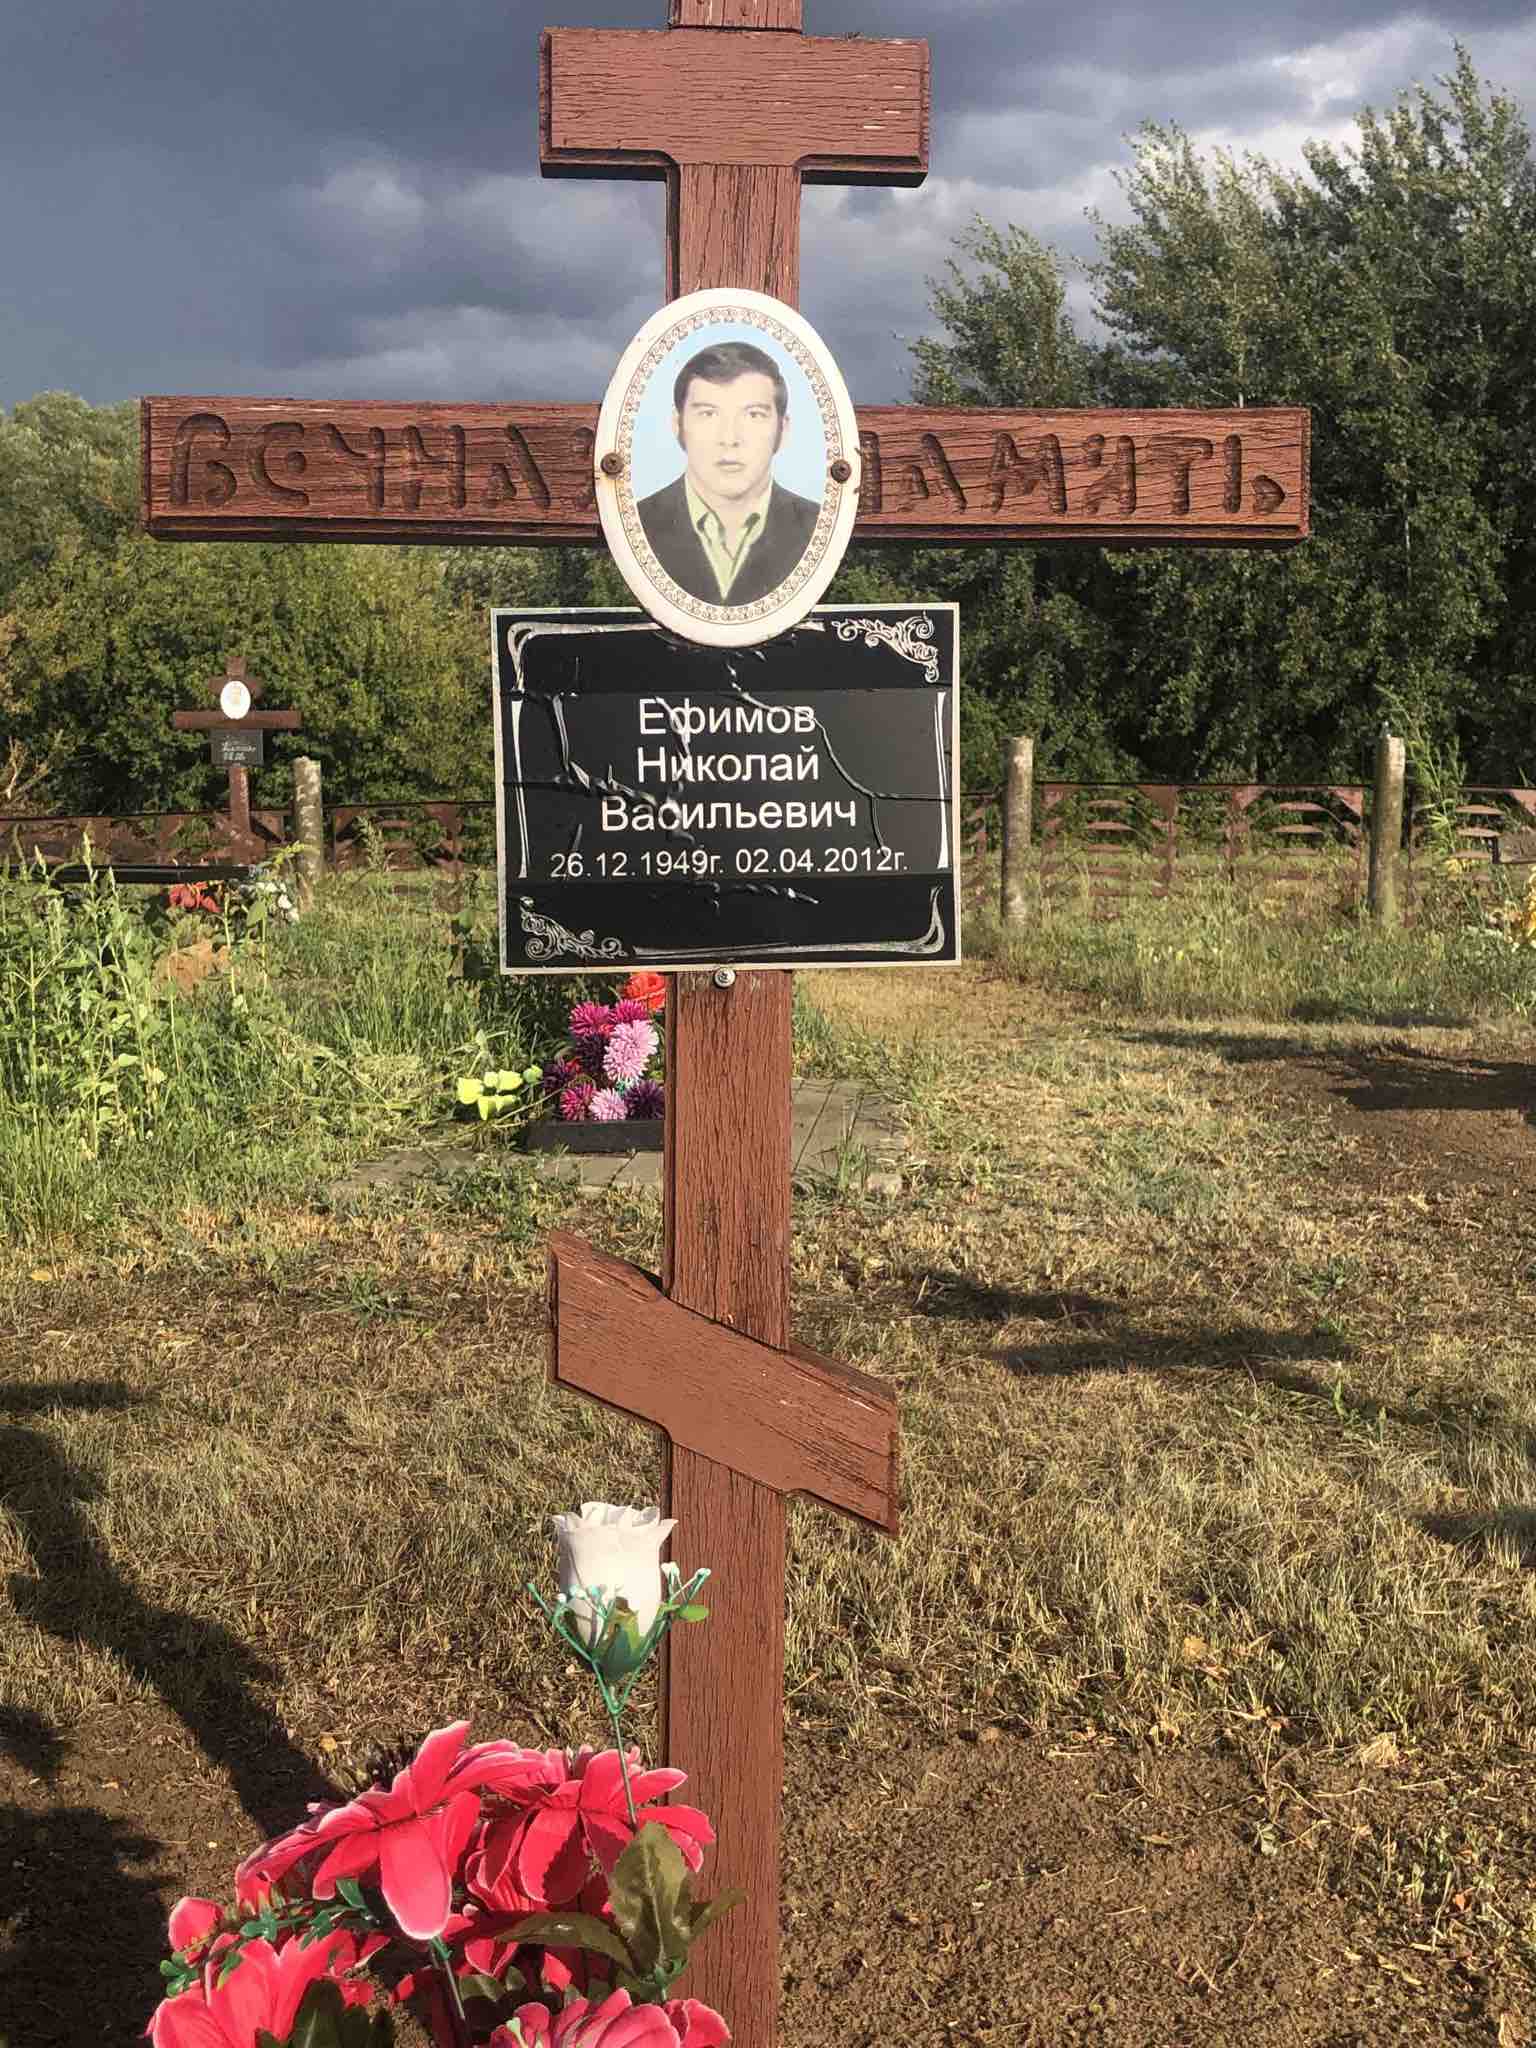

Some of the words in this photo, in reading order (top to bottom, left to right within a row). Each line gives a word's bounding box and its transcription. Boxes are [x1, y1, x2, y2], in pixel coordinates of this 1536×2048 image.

[639, 698, 816, 742] Ефимов
[637, 746, 819, 783] Николай
[602, 796, 857, 831] Васильевич
[550, 851, 724, 878] 26.12.1949г.
[736, 847, 909, 873] 02.04.2012г.
